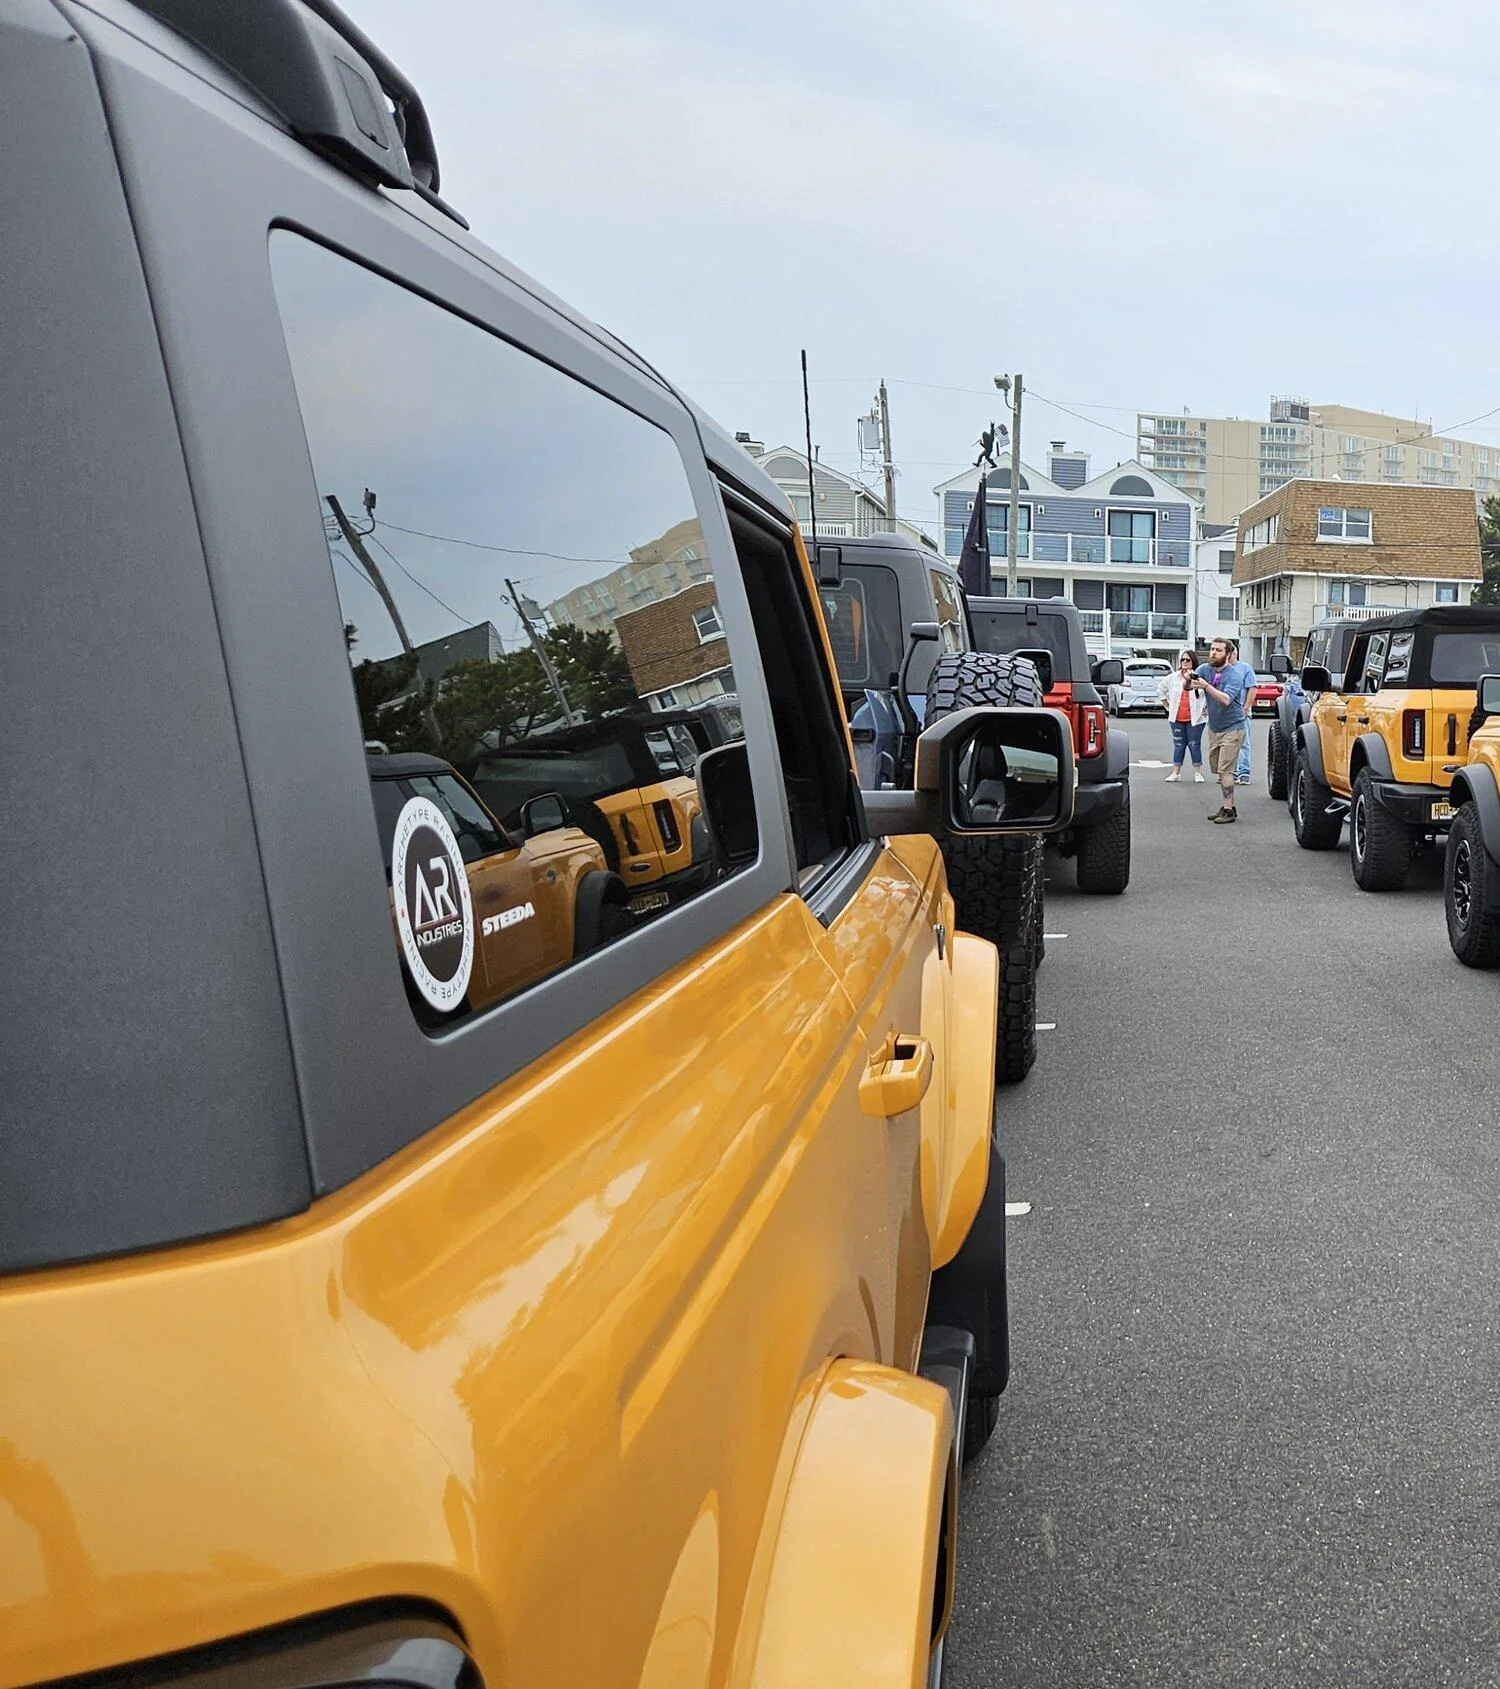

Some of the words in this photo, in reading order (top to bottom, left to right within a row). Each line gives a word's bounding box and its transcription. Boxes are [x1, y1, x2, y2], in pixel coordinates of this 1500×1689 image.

[397, 808, 430, 896] ARCHETYPE
[433, 815, 464, 881] RACING
[415, 855, 459, 928] AR
[482, 901, 536, 937] STEEDA
[404, 930, 437, 997] RACING
[416, 919, 463, 948] INDUSTRIES
[440, 914, 472, 999] ARCHETYPE
